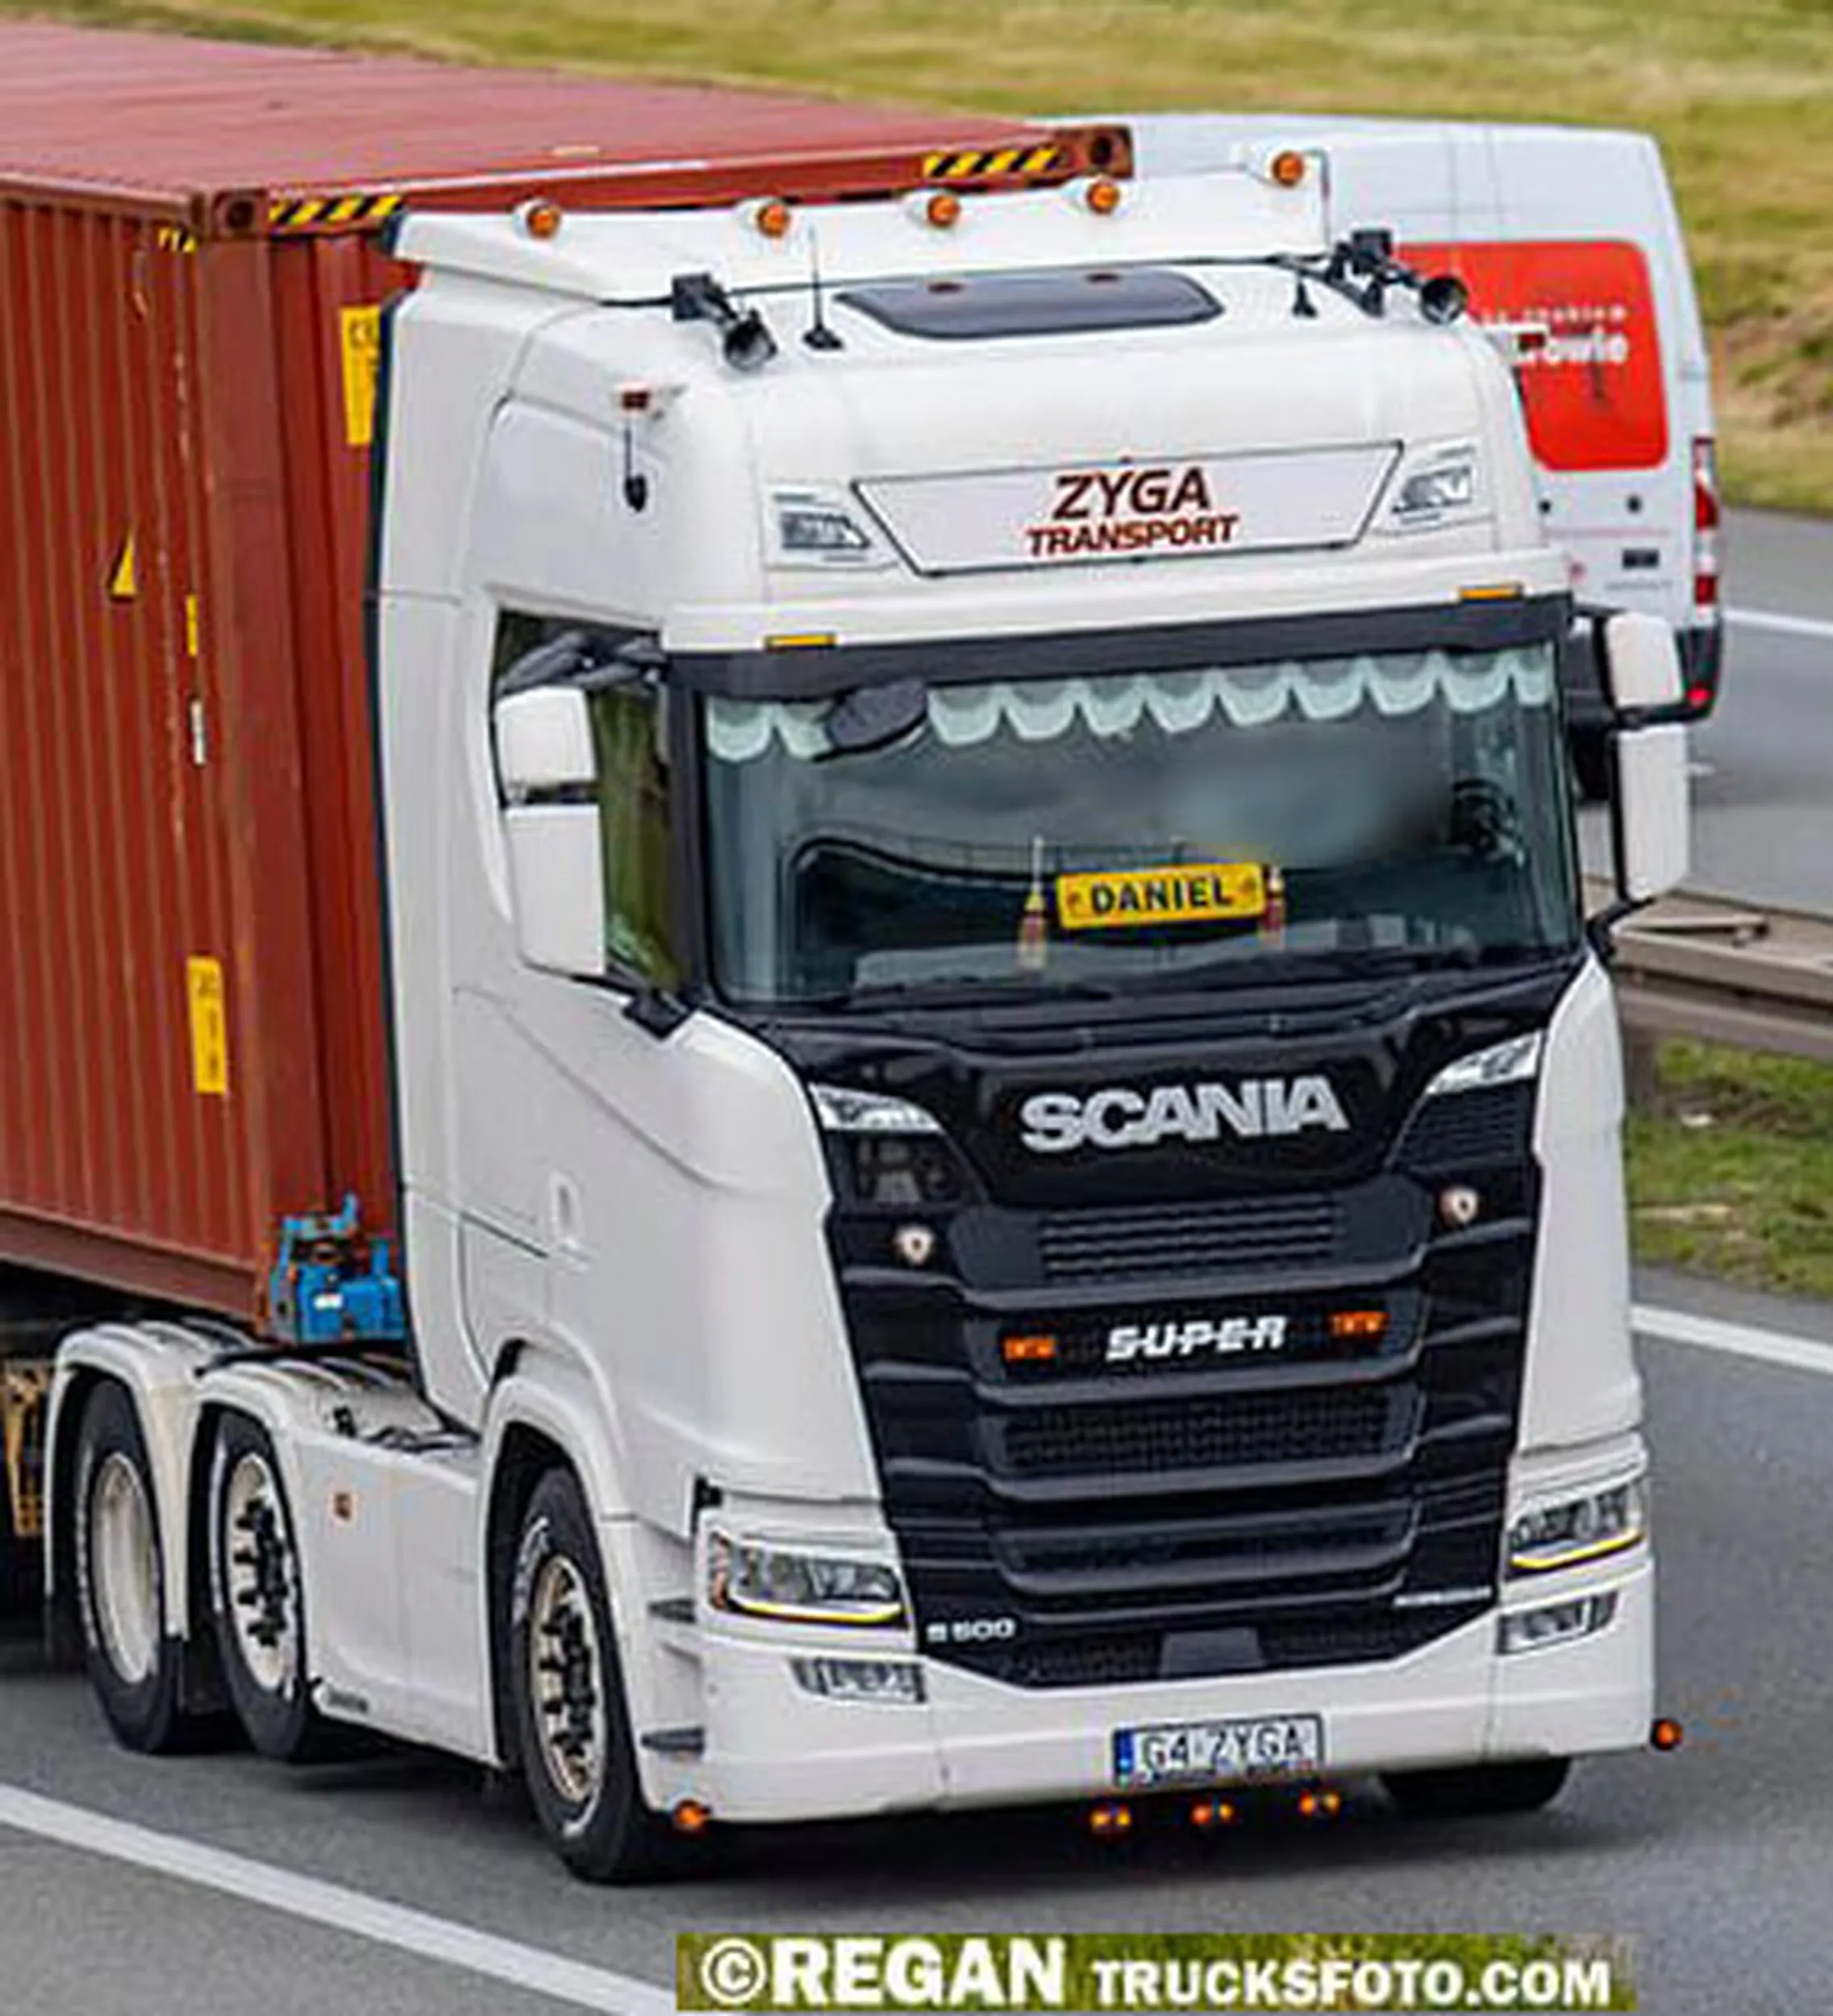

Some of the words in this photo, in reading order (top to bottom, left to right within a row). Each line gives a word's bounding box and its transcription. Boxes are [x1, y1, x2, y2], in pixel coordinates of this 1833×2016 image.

[1051, 467, 1210, 520] ZYGA
[1027, 515, 1239, 556] TRANSPORT
[1090, 876, 1234, 914] DANIEL
[1020, 1075, 1350, 1152] SCANIA
[1106, 1315, 1288, 1361] SUPER
